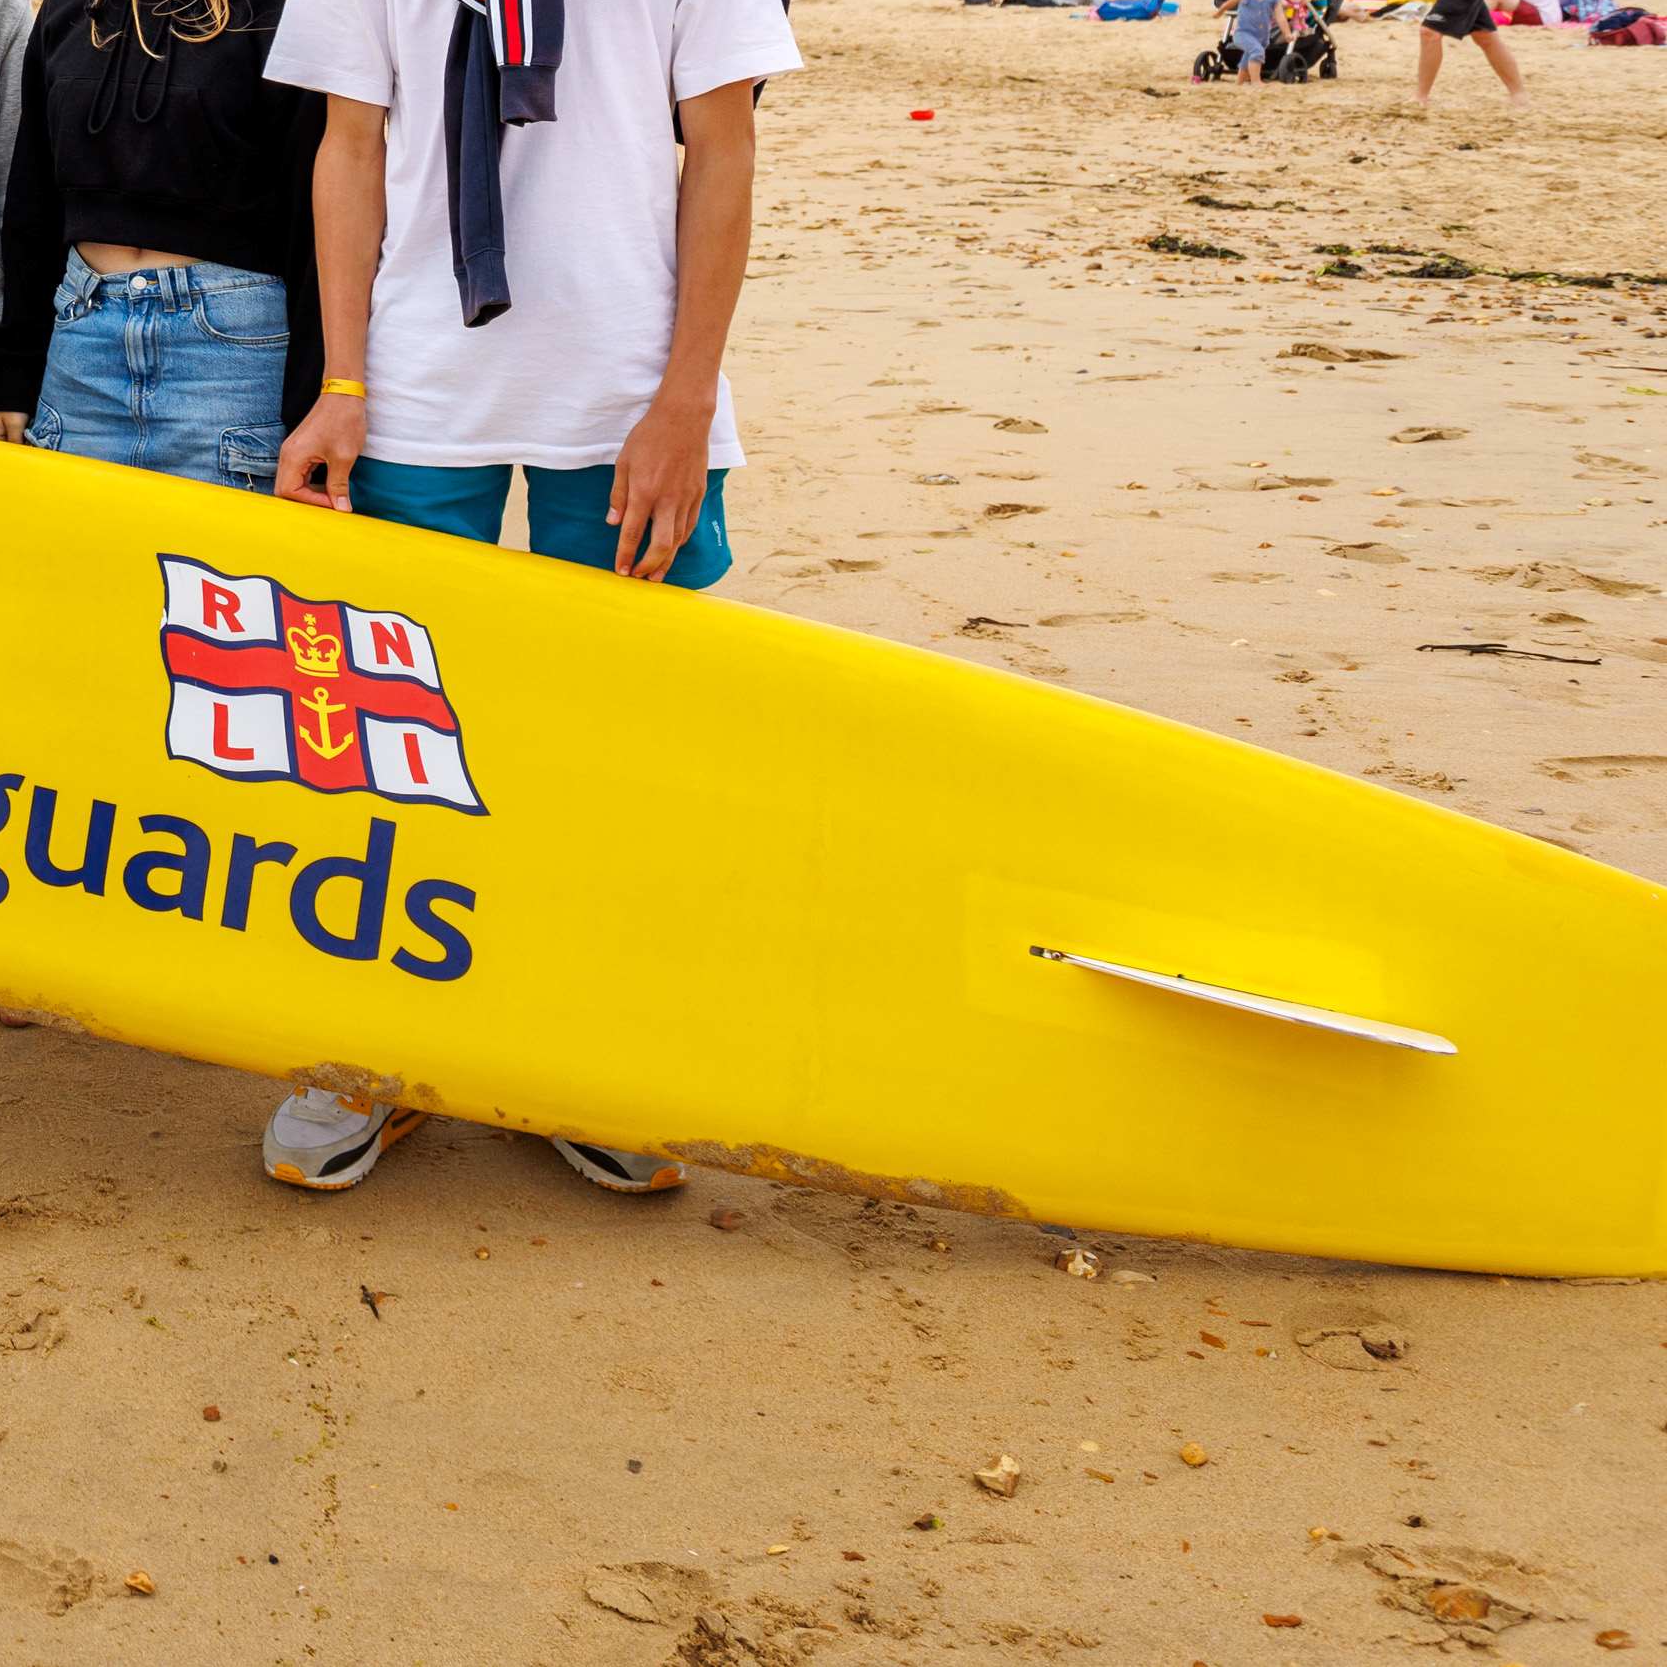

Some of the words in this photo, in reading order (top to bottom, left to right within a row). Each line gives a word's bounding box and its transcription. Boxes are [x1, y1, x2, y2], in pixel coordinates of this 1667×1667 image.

[200, 579, 247, 633] R
[371, 621, 415, 668] N
[212, 702, 255, 761] L
[402, 733, 429, 785] I
